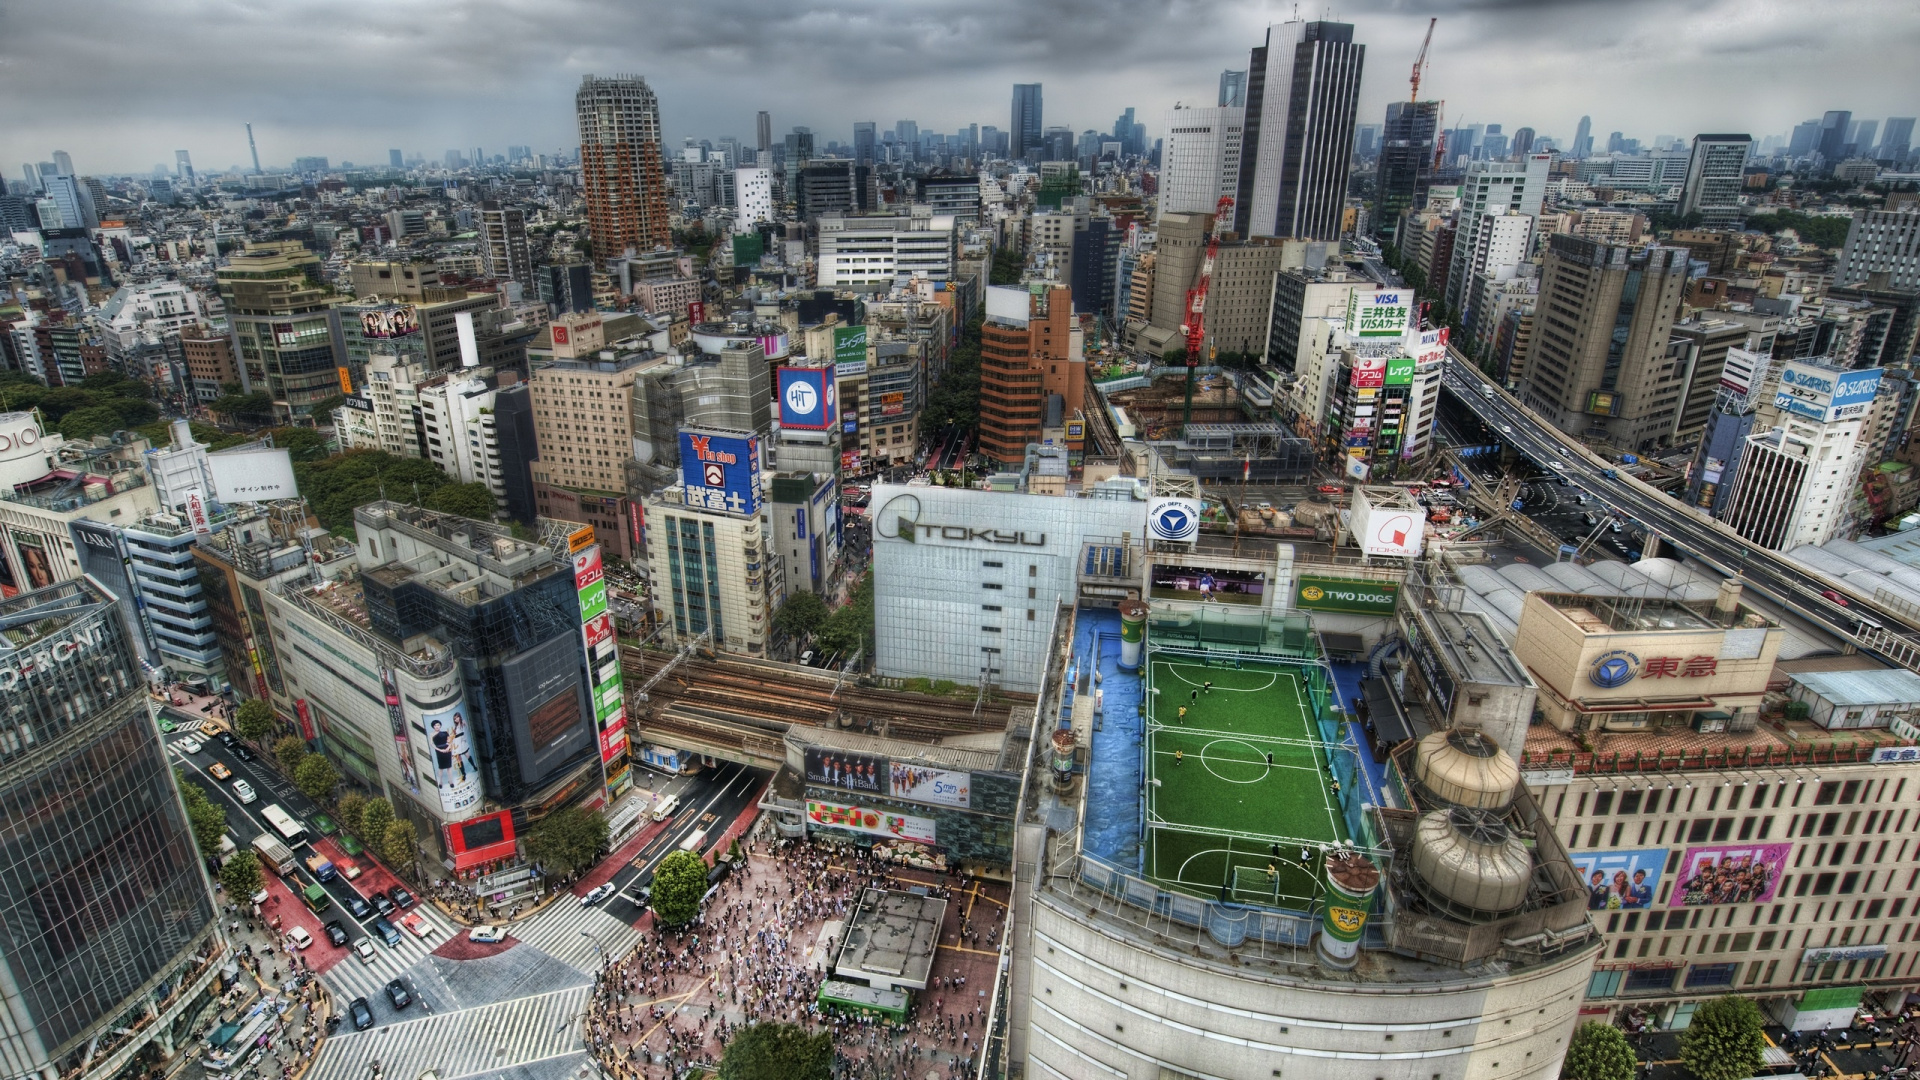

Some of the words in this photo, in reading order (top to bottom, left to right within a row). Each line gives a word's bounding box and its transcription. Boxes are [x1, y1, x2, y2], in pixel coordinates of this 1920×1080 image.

[1374, 294, 1399, 304] VISA
[1361, 306, 1407, 319] 三井住友
[1360, 318, 1406, 329] VISAカード
[1421, 332, 1439, 345] MIKI
[1360, 371, 1382, 379] アコム
[1389, 366, 1412, 376] レイク
[1794, 373, 1832, 394] STARTS
[1845, 379, 1878, 397] STARTS
[1776, 396, 1791, 407] OZ
[1790, 387, 1818, 401] スターツ
[716, 451, 737, 466] shop
[686, 484, 746, 513] 武富士
[750, 472, 761, 511] 武富士
[189, 493, 206, 526] 大和証券
[1151, 503, 1166, 516] TOKYU
[1183, 504, 1198, 518] STORE
[77, 529, 116, 549] ZARA
[572, 532, 594, 548] プロミス
[915, 523, 1046, 547] TOKYU
[579, 569, 603, 586] アコム
[581, 589, 605, 612] レイク
[1325, 590, 1356, 601] TWO
[1356, 593, 1394, 604] DOGS
[587, 628, 610, 645] アイフル
[1591, 652, 1610, 666] TOKYU
[1640, 655, 1718, 679] 東急
[1420, 657, 1435, 690] FUTSAL
[1434, 683, 1447, 712] PARK
[807, 771, 831, 784] Smap
[933, 780, 943, 794] 5
[1331, 907, 1348, 915] TWO
